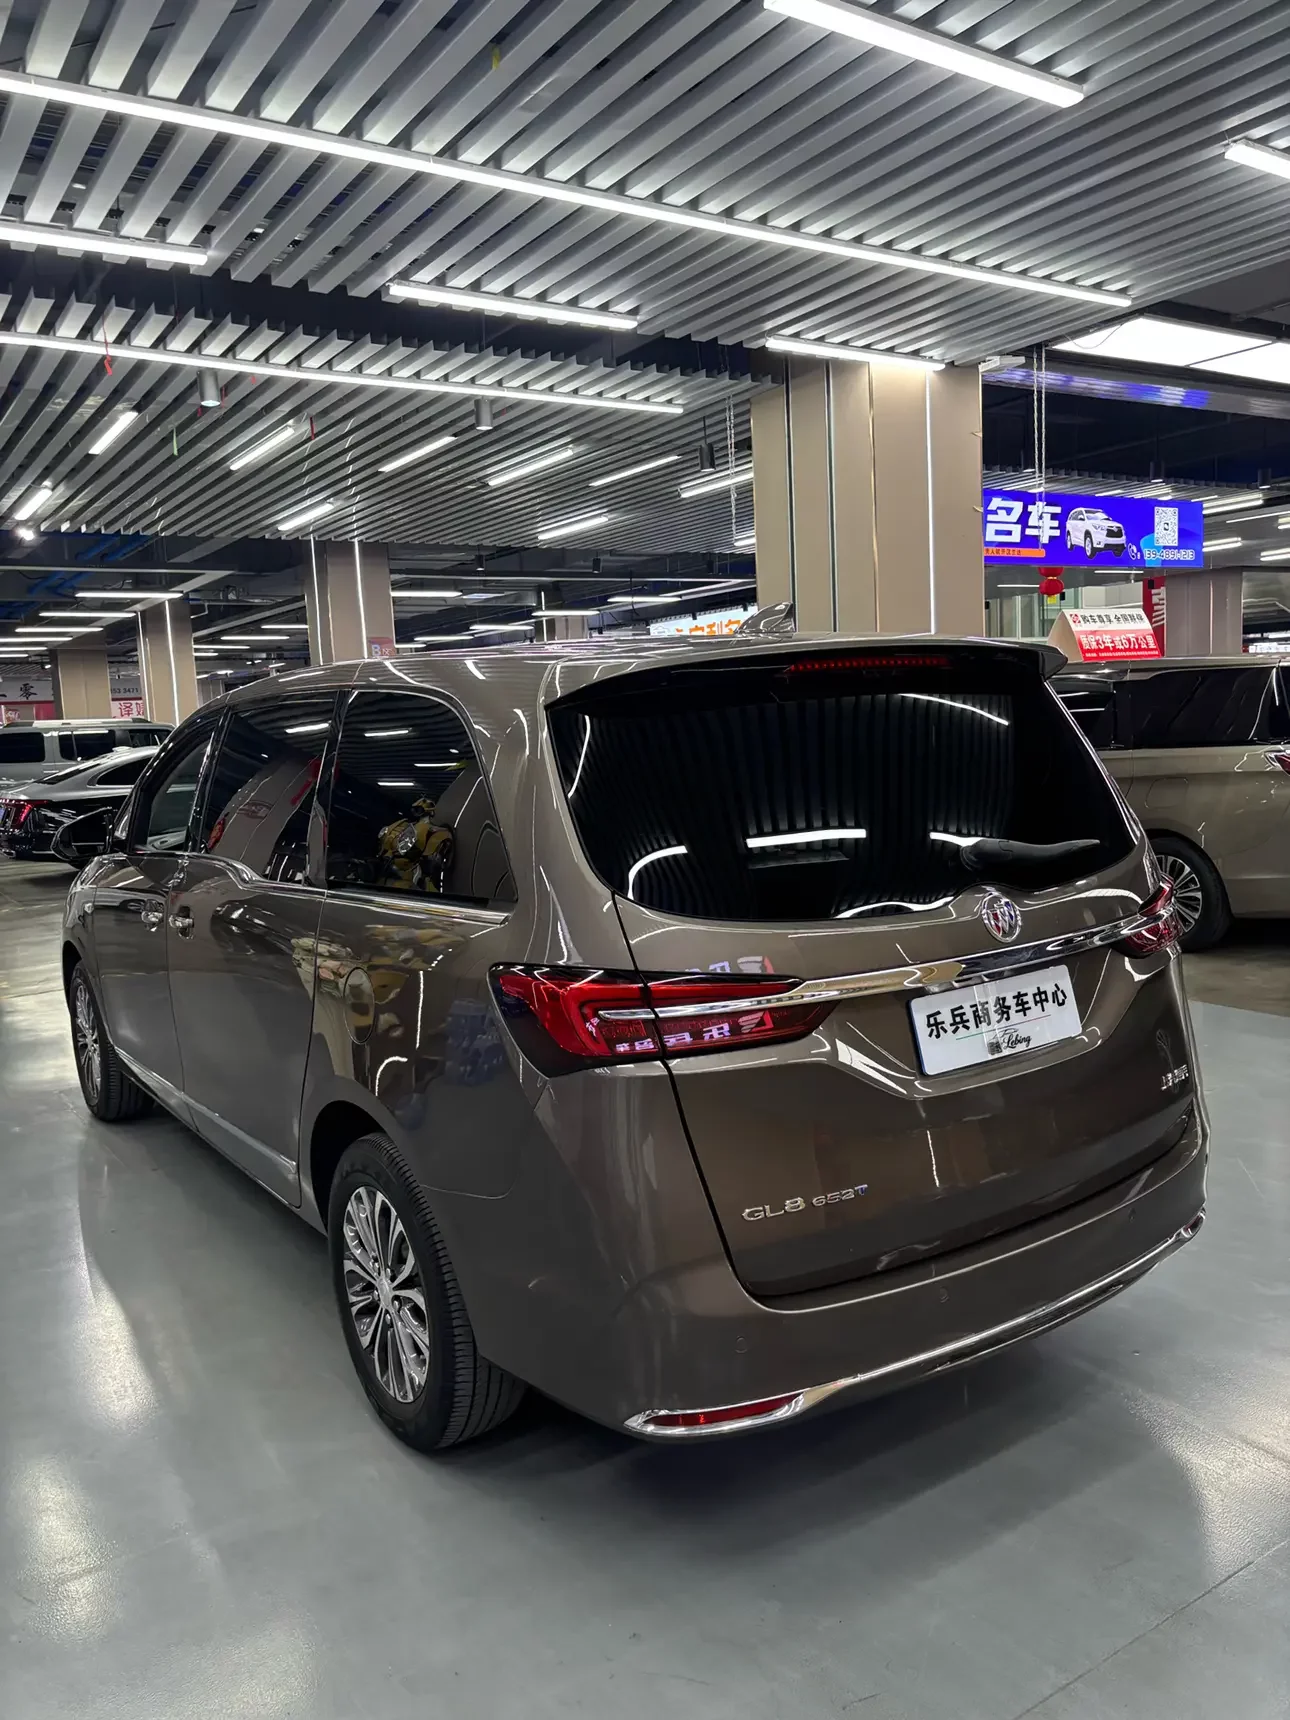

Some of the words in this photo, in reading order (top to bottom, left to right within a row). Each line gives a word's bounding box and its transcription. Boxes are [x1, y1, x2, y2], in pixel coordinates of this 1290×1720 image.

[985, 497, 1062, 544] 名车
[1080, 633, 1157, 651] 质保3年或6万公里
[926, 983, 1067, 1039] 乐兵商务车中心
[1003, 1033, 1031, 1049] Lebing
[742, 1197, 806, 1221] GL8
